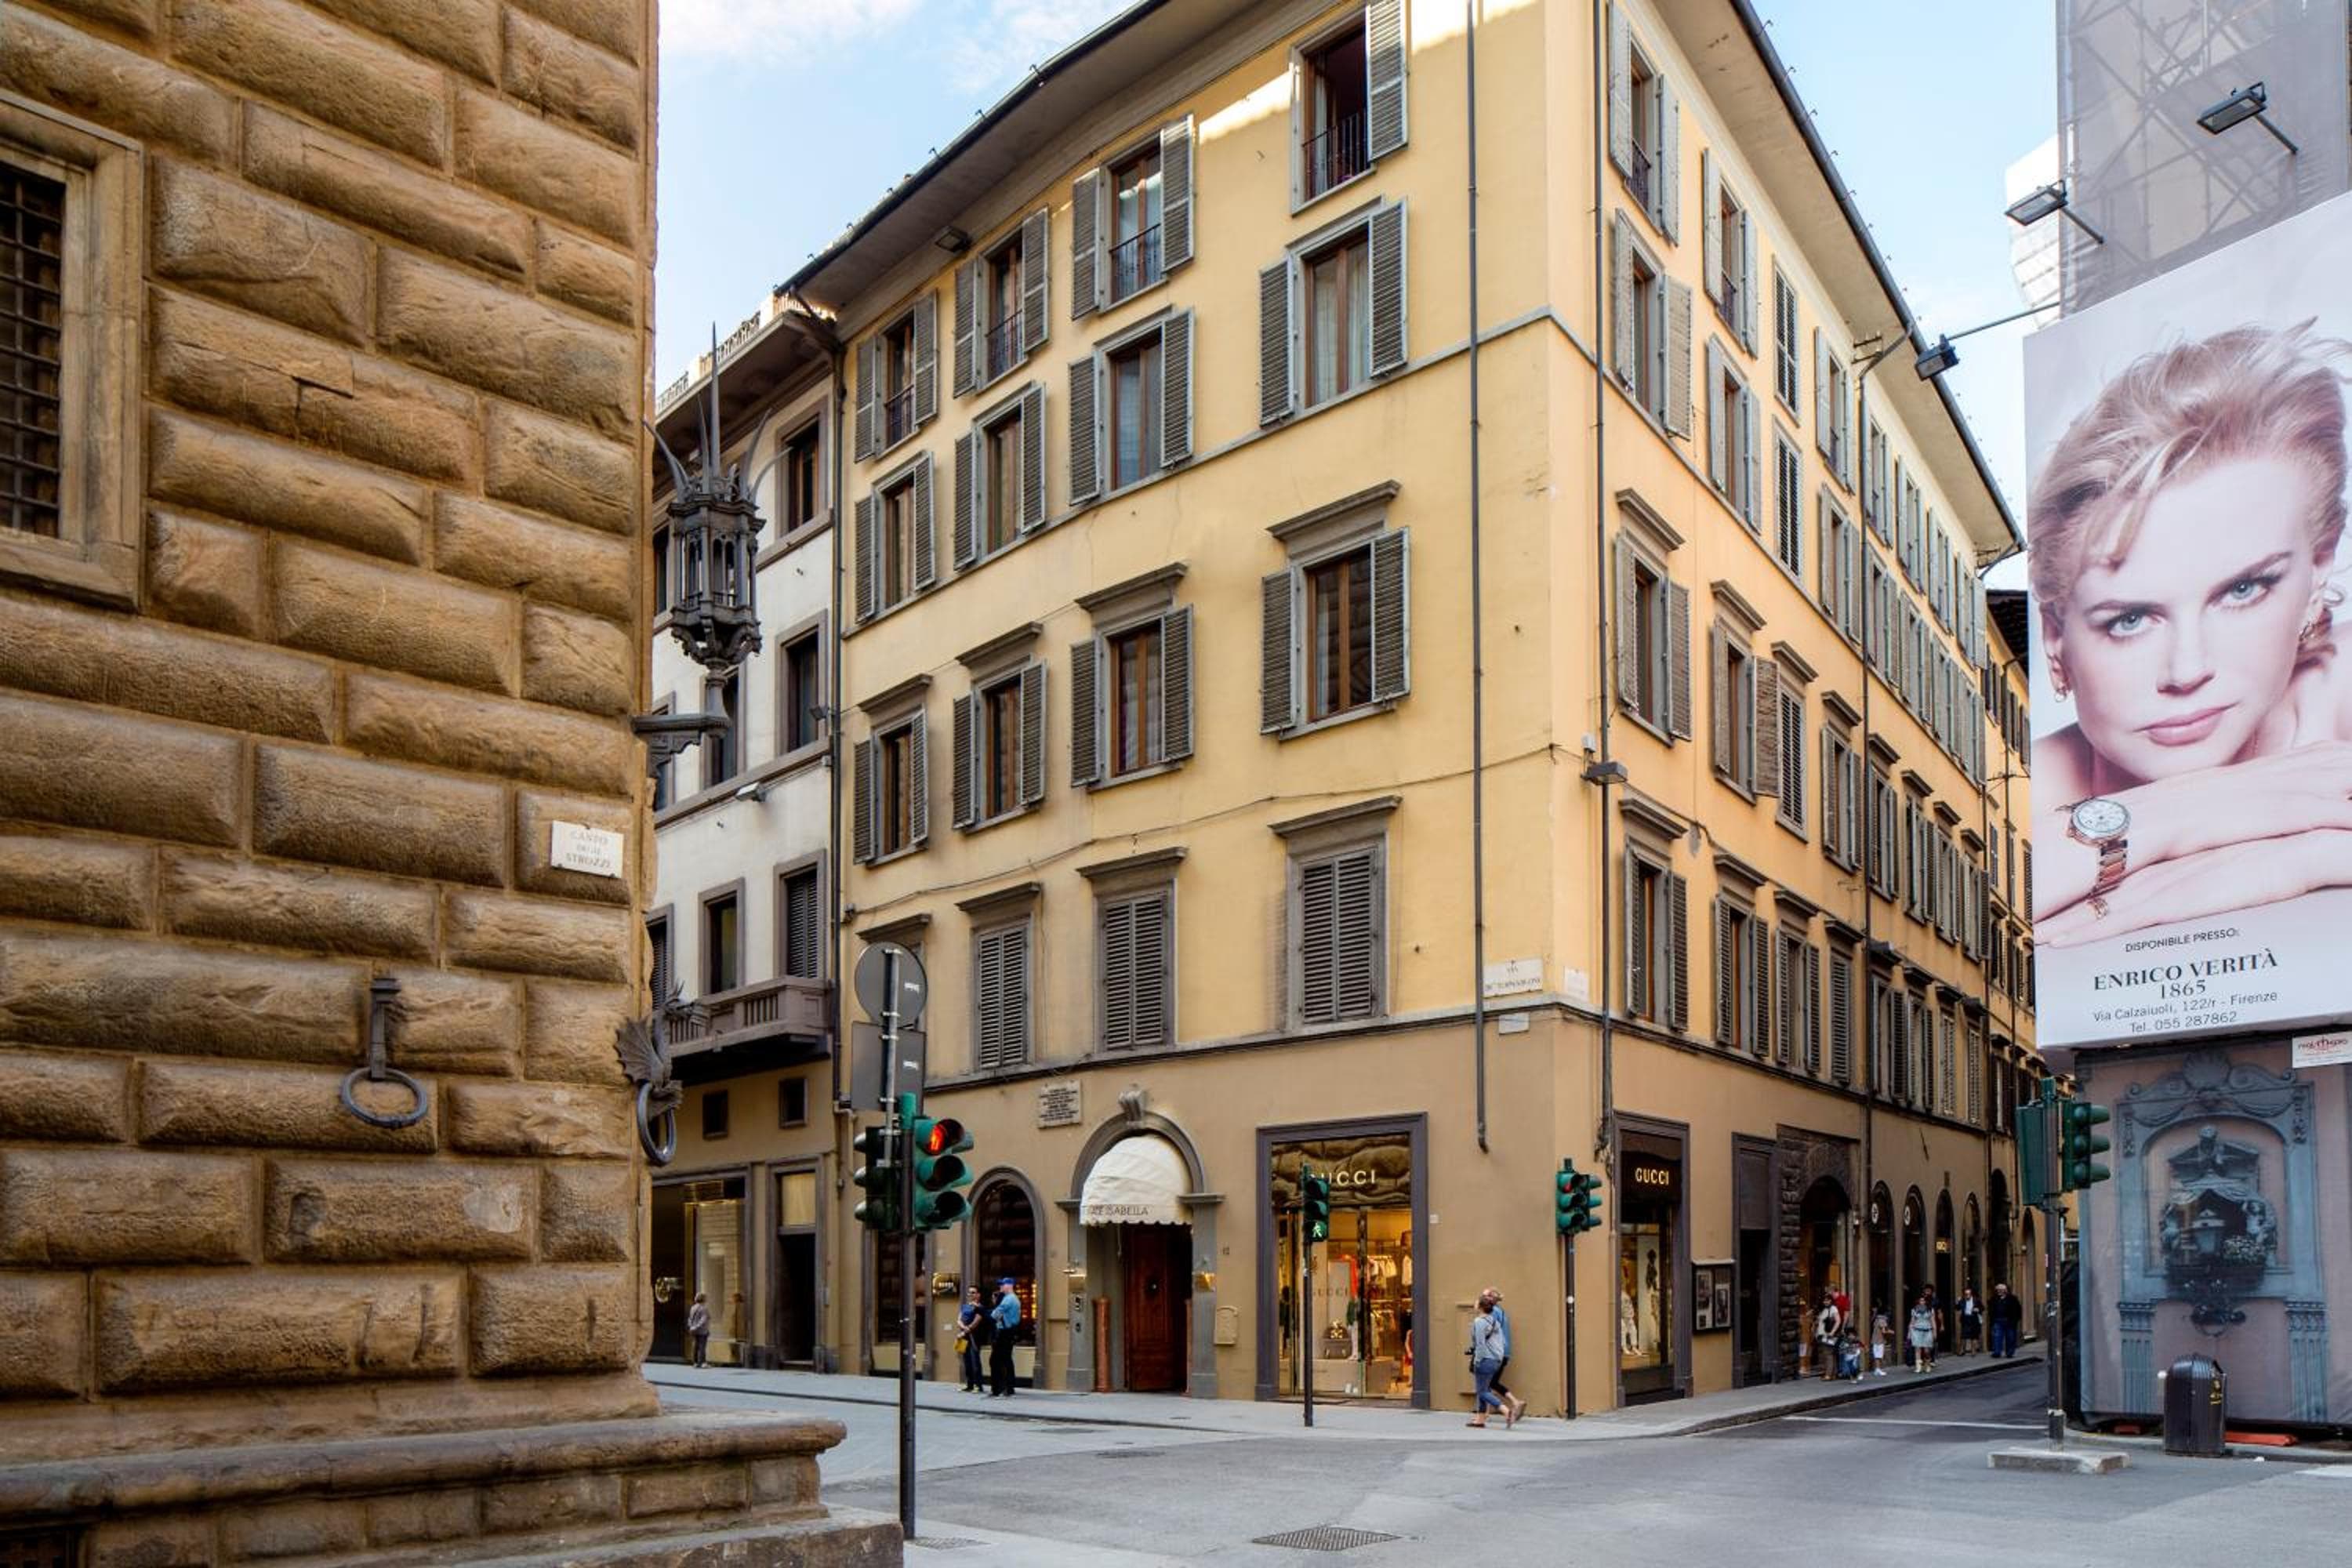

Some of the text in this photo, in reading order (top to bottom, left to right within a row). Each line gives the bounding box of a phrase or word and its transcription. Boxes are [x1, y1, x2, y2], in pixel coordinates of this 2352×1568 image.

[2125, 935, 2191, 953] DISPONIBILE
[2094, 949, 2278, 990] ENRICO VERITÀ
[2161, 979, 2206, 1000] 1865
[2094, 1011, 2111, 1022] Via
[2183, 997, 2216, 1012] 122/r
[2230, 992, 2278, 1006] Firenze
[2129, 1011, 2238, 1033] Tel. 055 287862
[1635, 1167, 1669, 1185] GUCCI
